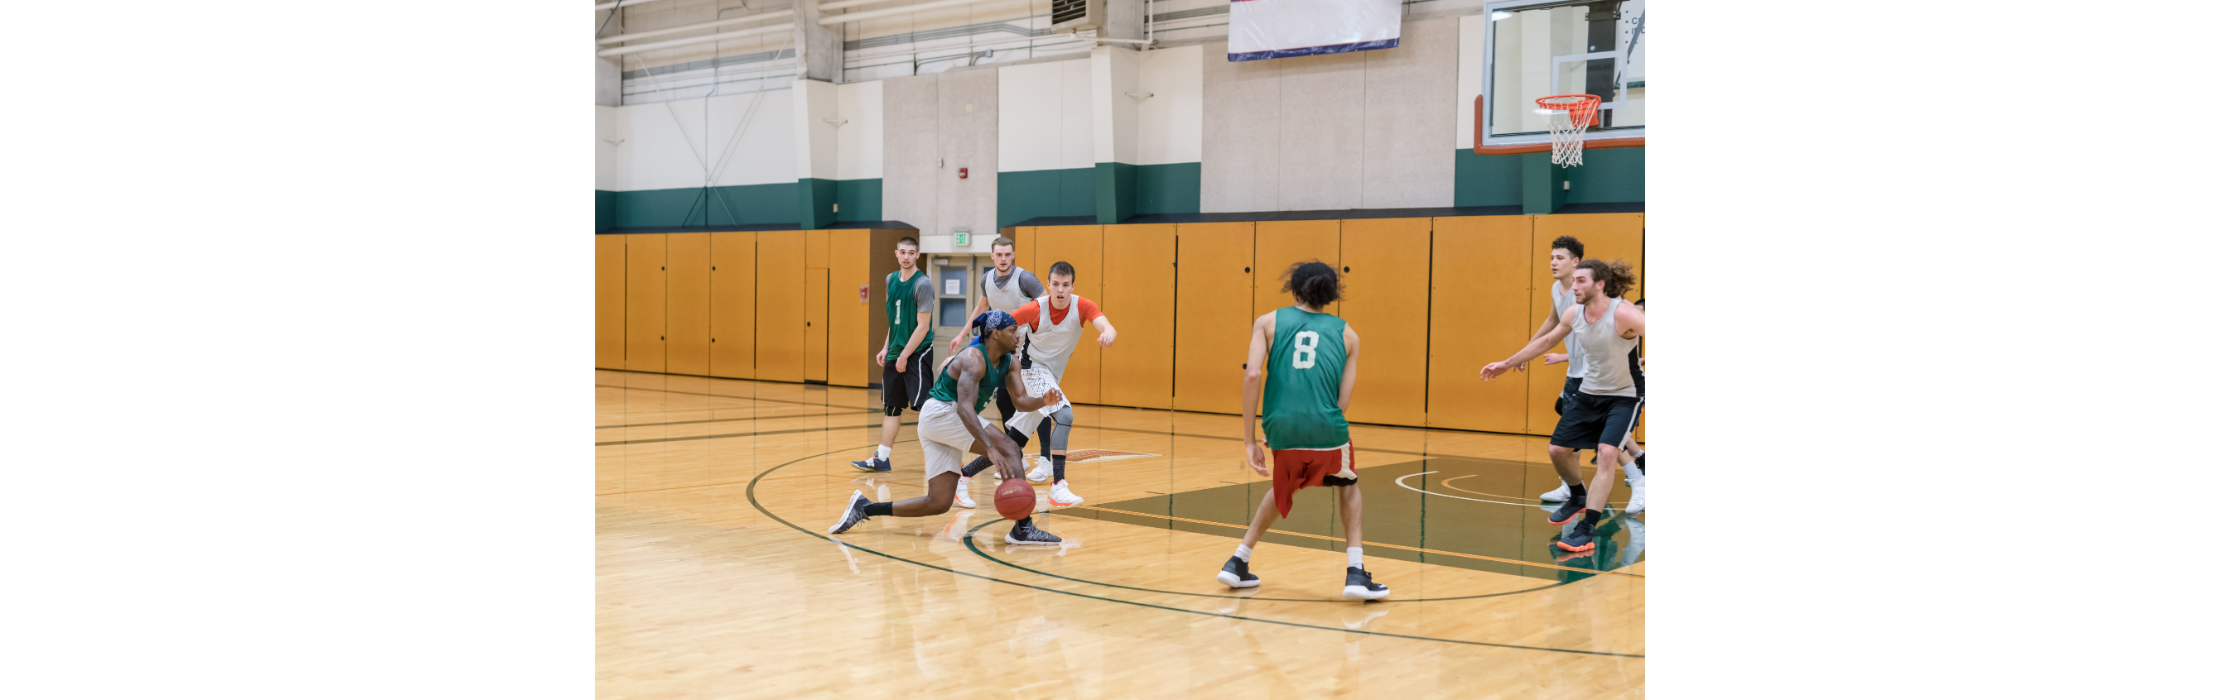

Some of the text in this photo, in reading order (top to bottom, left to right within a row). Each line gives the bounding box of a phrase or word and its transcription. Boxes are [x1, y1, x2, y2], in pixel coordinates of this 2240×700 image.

[956, 233, 967, 245] EXIT
[895, 299, 901, 325] 1
[1292, 330, 1320, 369] 8
